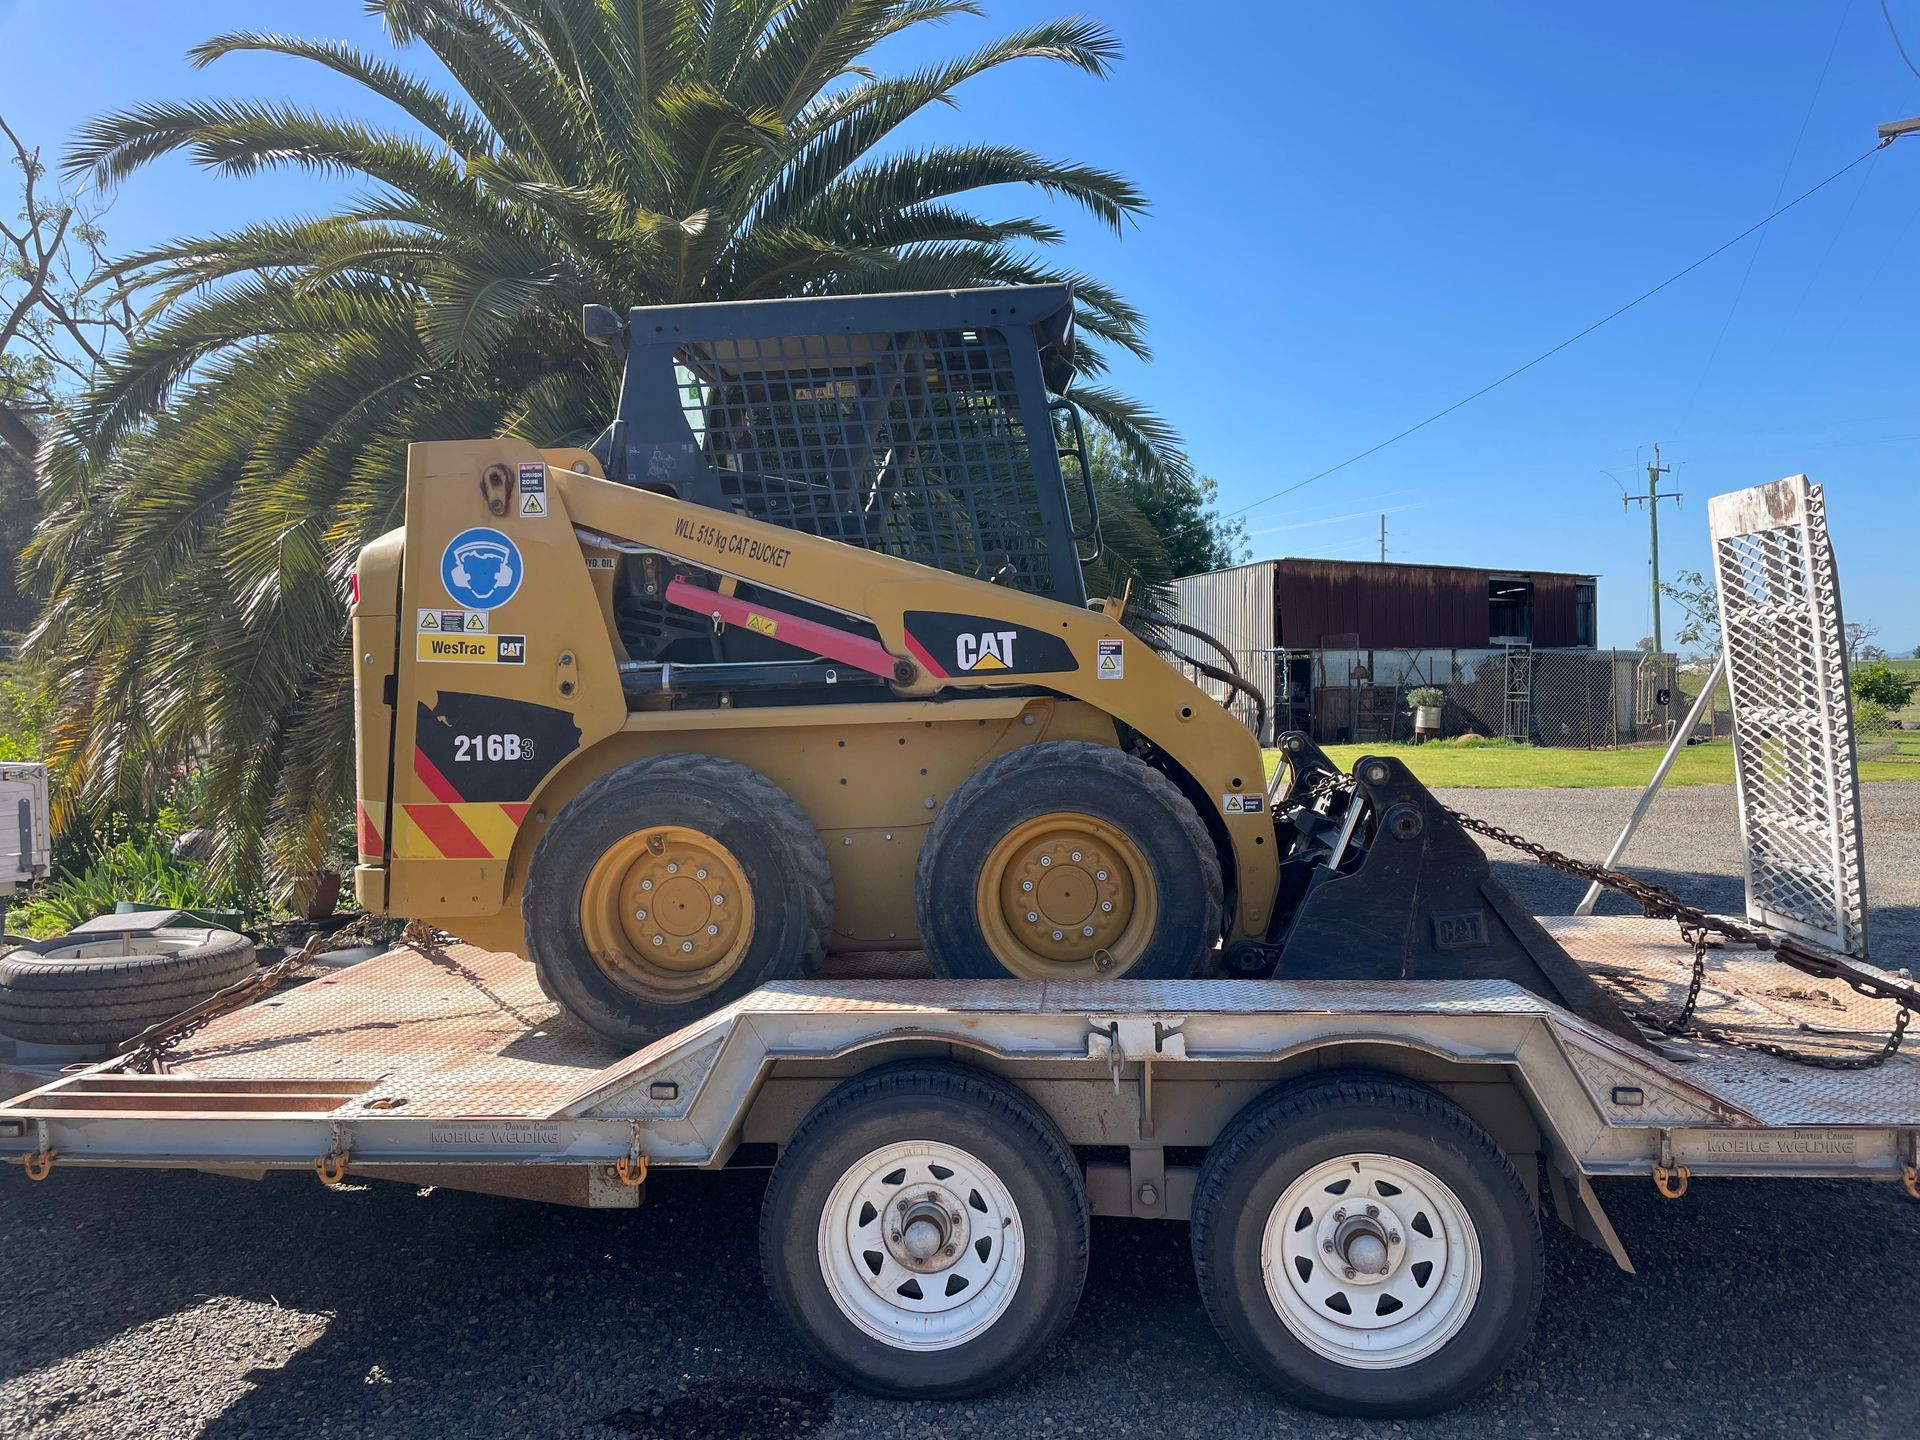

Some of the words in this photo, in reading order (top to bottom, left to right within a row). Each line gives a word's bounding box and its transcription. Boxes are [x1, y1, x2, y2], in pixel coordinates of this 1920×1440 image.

[674, 518, 695, 540] WLL
[696, 525, 715, 545] 515
[714, 530, 727, 553] kg
[728, 534, 750, 556] CAT
[748, 541, 791, 568] BUCKET
[601, 559, 613, 568] OIL
[431, 640, 486, 655] WesTrac
[500, 642, 522, 657] CAT
[956, 631, 1017, 671] CAT
[1440, 917, 1480, 943] CAT
[431, 1131, 485, 1144] MOBILE
[491, 1131, 559, 1144] WELDING
[1707, 1140, 1770, 1153] MOBILE
[1777, 1140, 1854, 1154] WELDING
